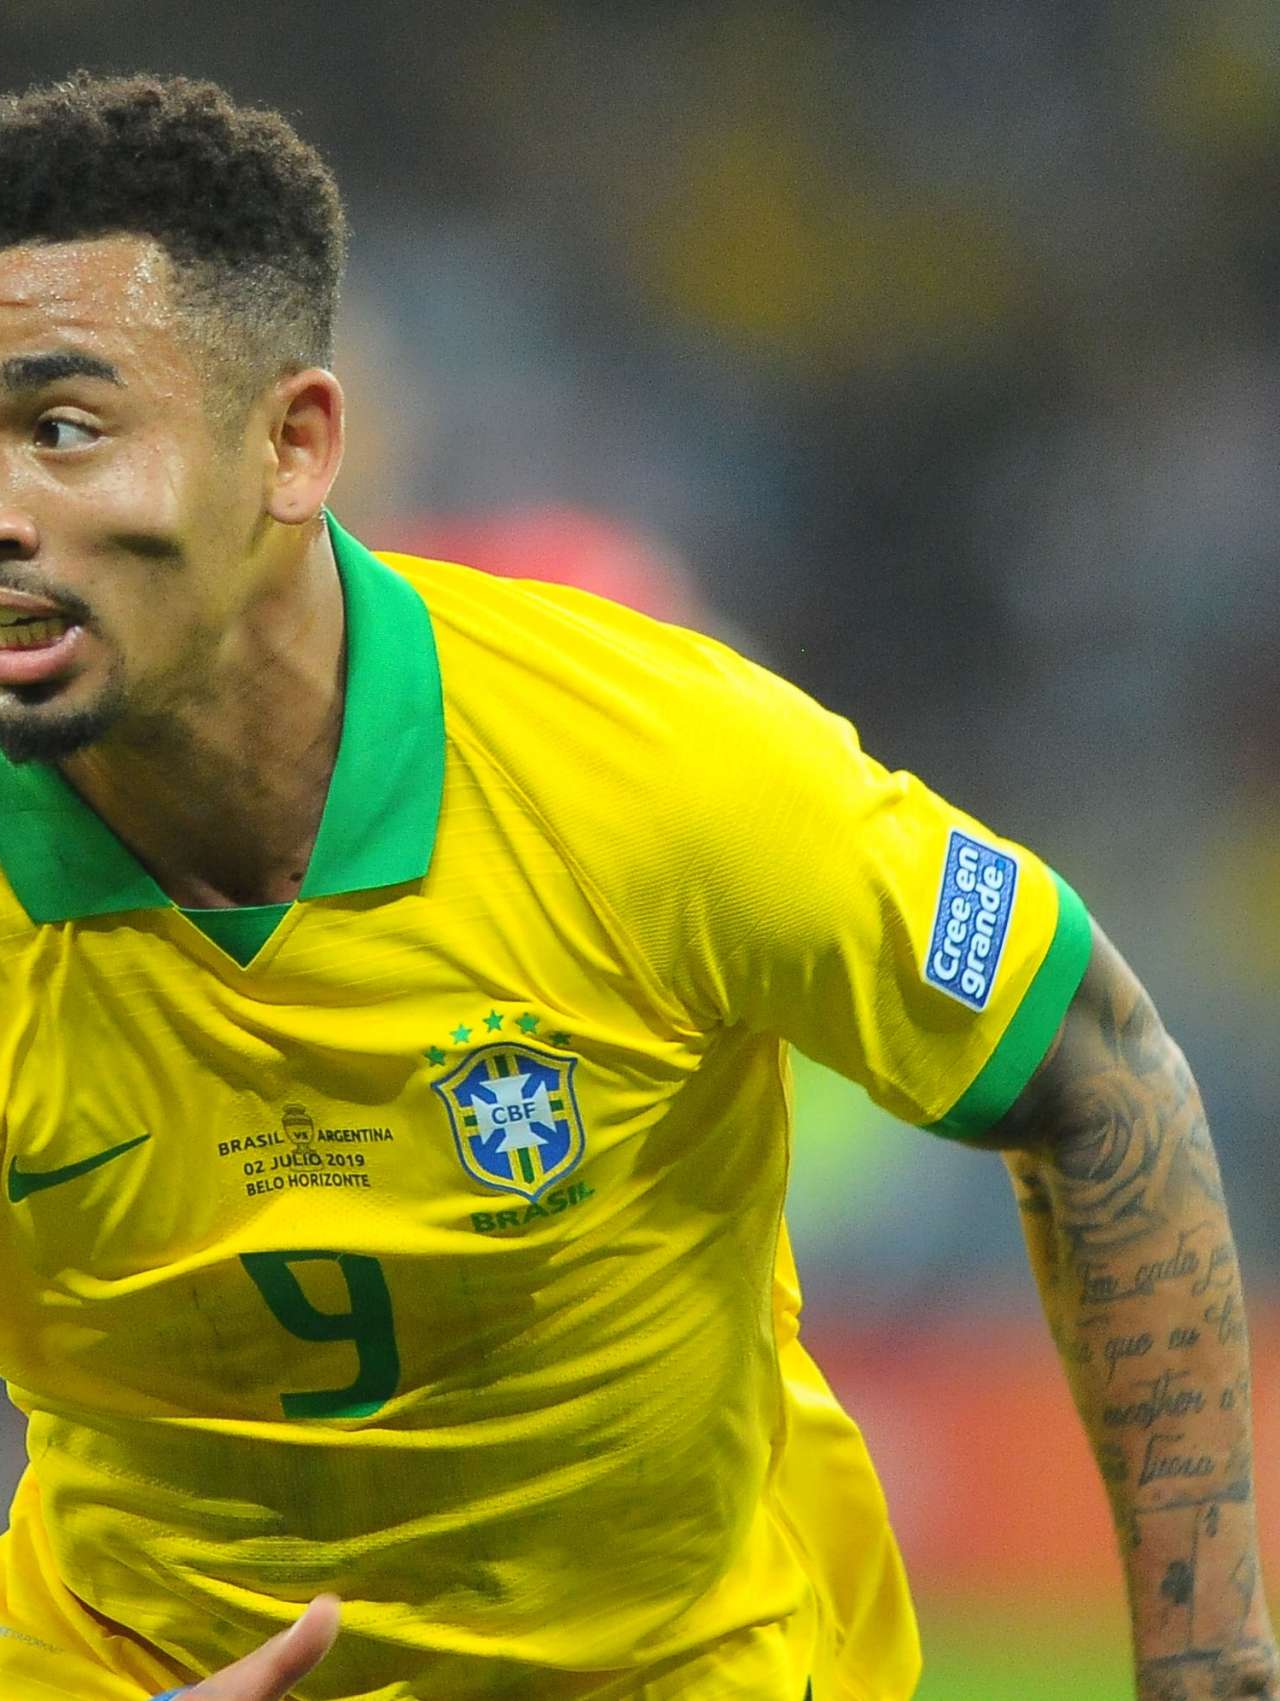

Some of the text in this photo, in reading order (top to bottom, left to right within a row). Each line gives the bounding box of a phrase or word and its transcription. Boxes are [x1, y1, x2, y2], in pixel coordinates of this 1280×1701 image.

[933, 846, 980, 982] Cree en
[491, 1102, 536, 1125] CBF
[218, 1131, 285, 1156] BRASIL
[317, 1128, 394, 1143] ARGENTINA
[243, 1153, 365, 1176] 02 JULIO 2019
[246, 1173, 371, 1196] BELO HORIZONTE
[470, 1181, 595, 1232] BRASIL
[239, 1250, 401, 1420] 9
